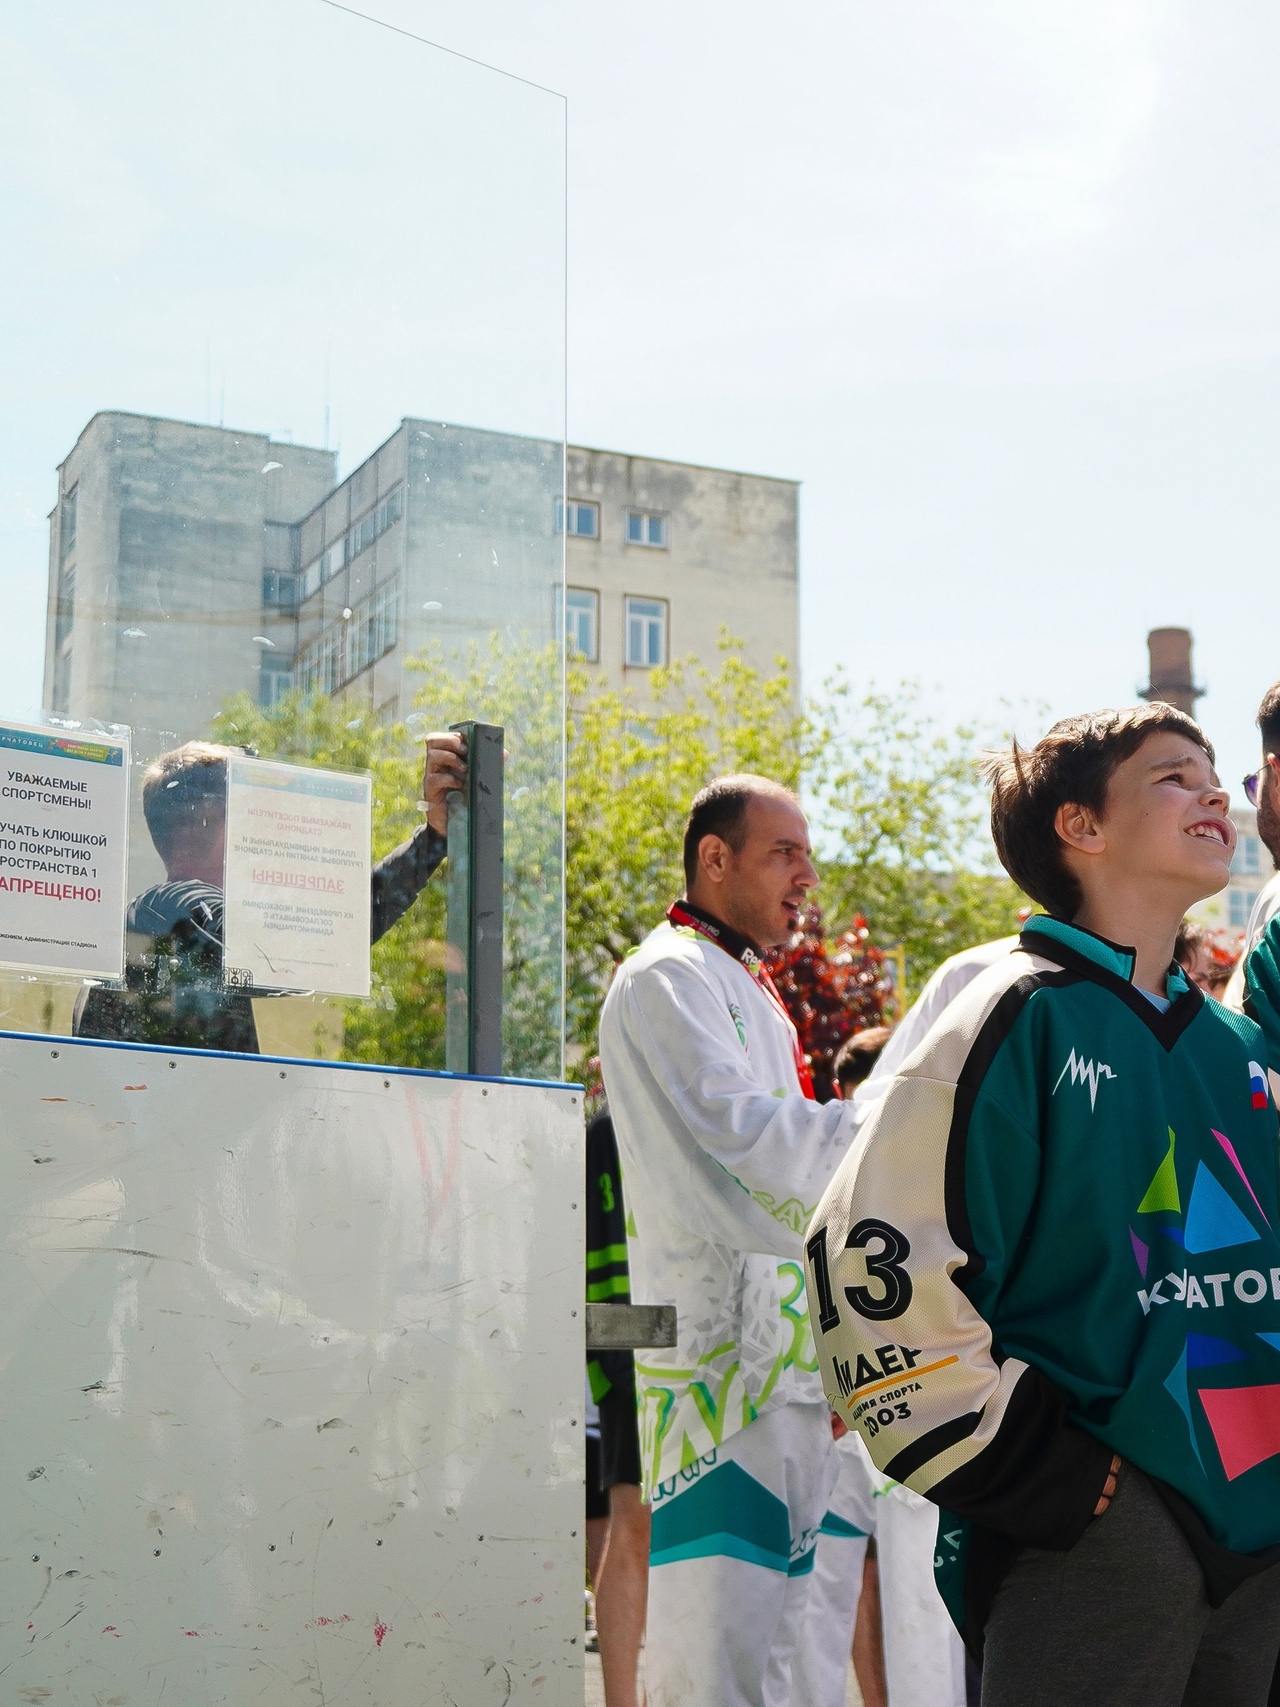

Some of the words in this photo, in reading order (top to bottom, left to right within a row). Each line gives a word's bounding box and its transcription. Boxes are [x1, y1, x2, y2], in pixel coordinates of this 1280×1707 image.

[1, 736, 44, 748] РЧАТОВЕЦ
[7, 770, 88, 793] УВАЖАЕМЫЕ
[1, 787, 92, 810] СПОРТСМЕНЫ!
[0, 822, 40, 837] УЧАТЬ
[42, 828, 107, 847] КЛЮШКОЙ
[19, 841, 91, 861] ПОКРЫТИЮ
[0, 856, 88, 877] РОСТРАНСТВА
[91, 868, 97, 878] 1
[0, 876, 102, 903] АПРЕЩЕНО!
[0, 932, 24, 942] ЖЕНИЕМ,
[24, 936, 71, 946] АДМИНИСТРАЦИЯ
[70, 941, 98, 949] СТАДИОНА
[807, 1218, 911, 1334] 13
[879, 1382, 923, 1404] СПОРТА
